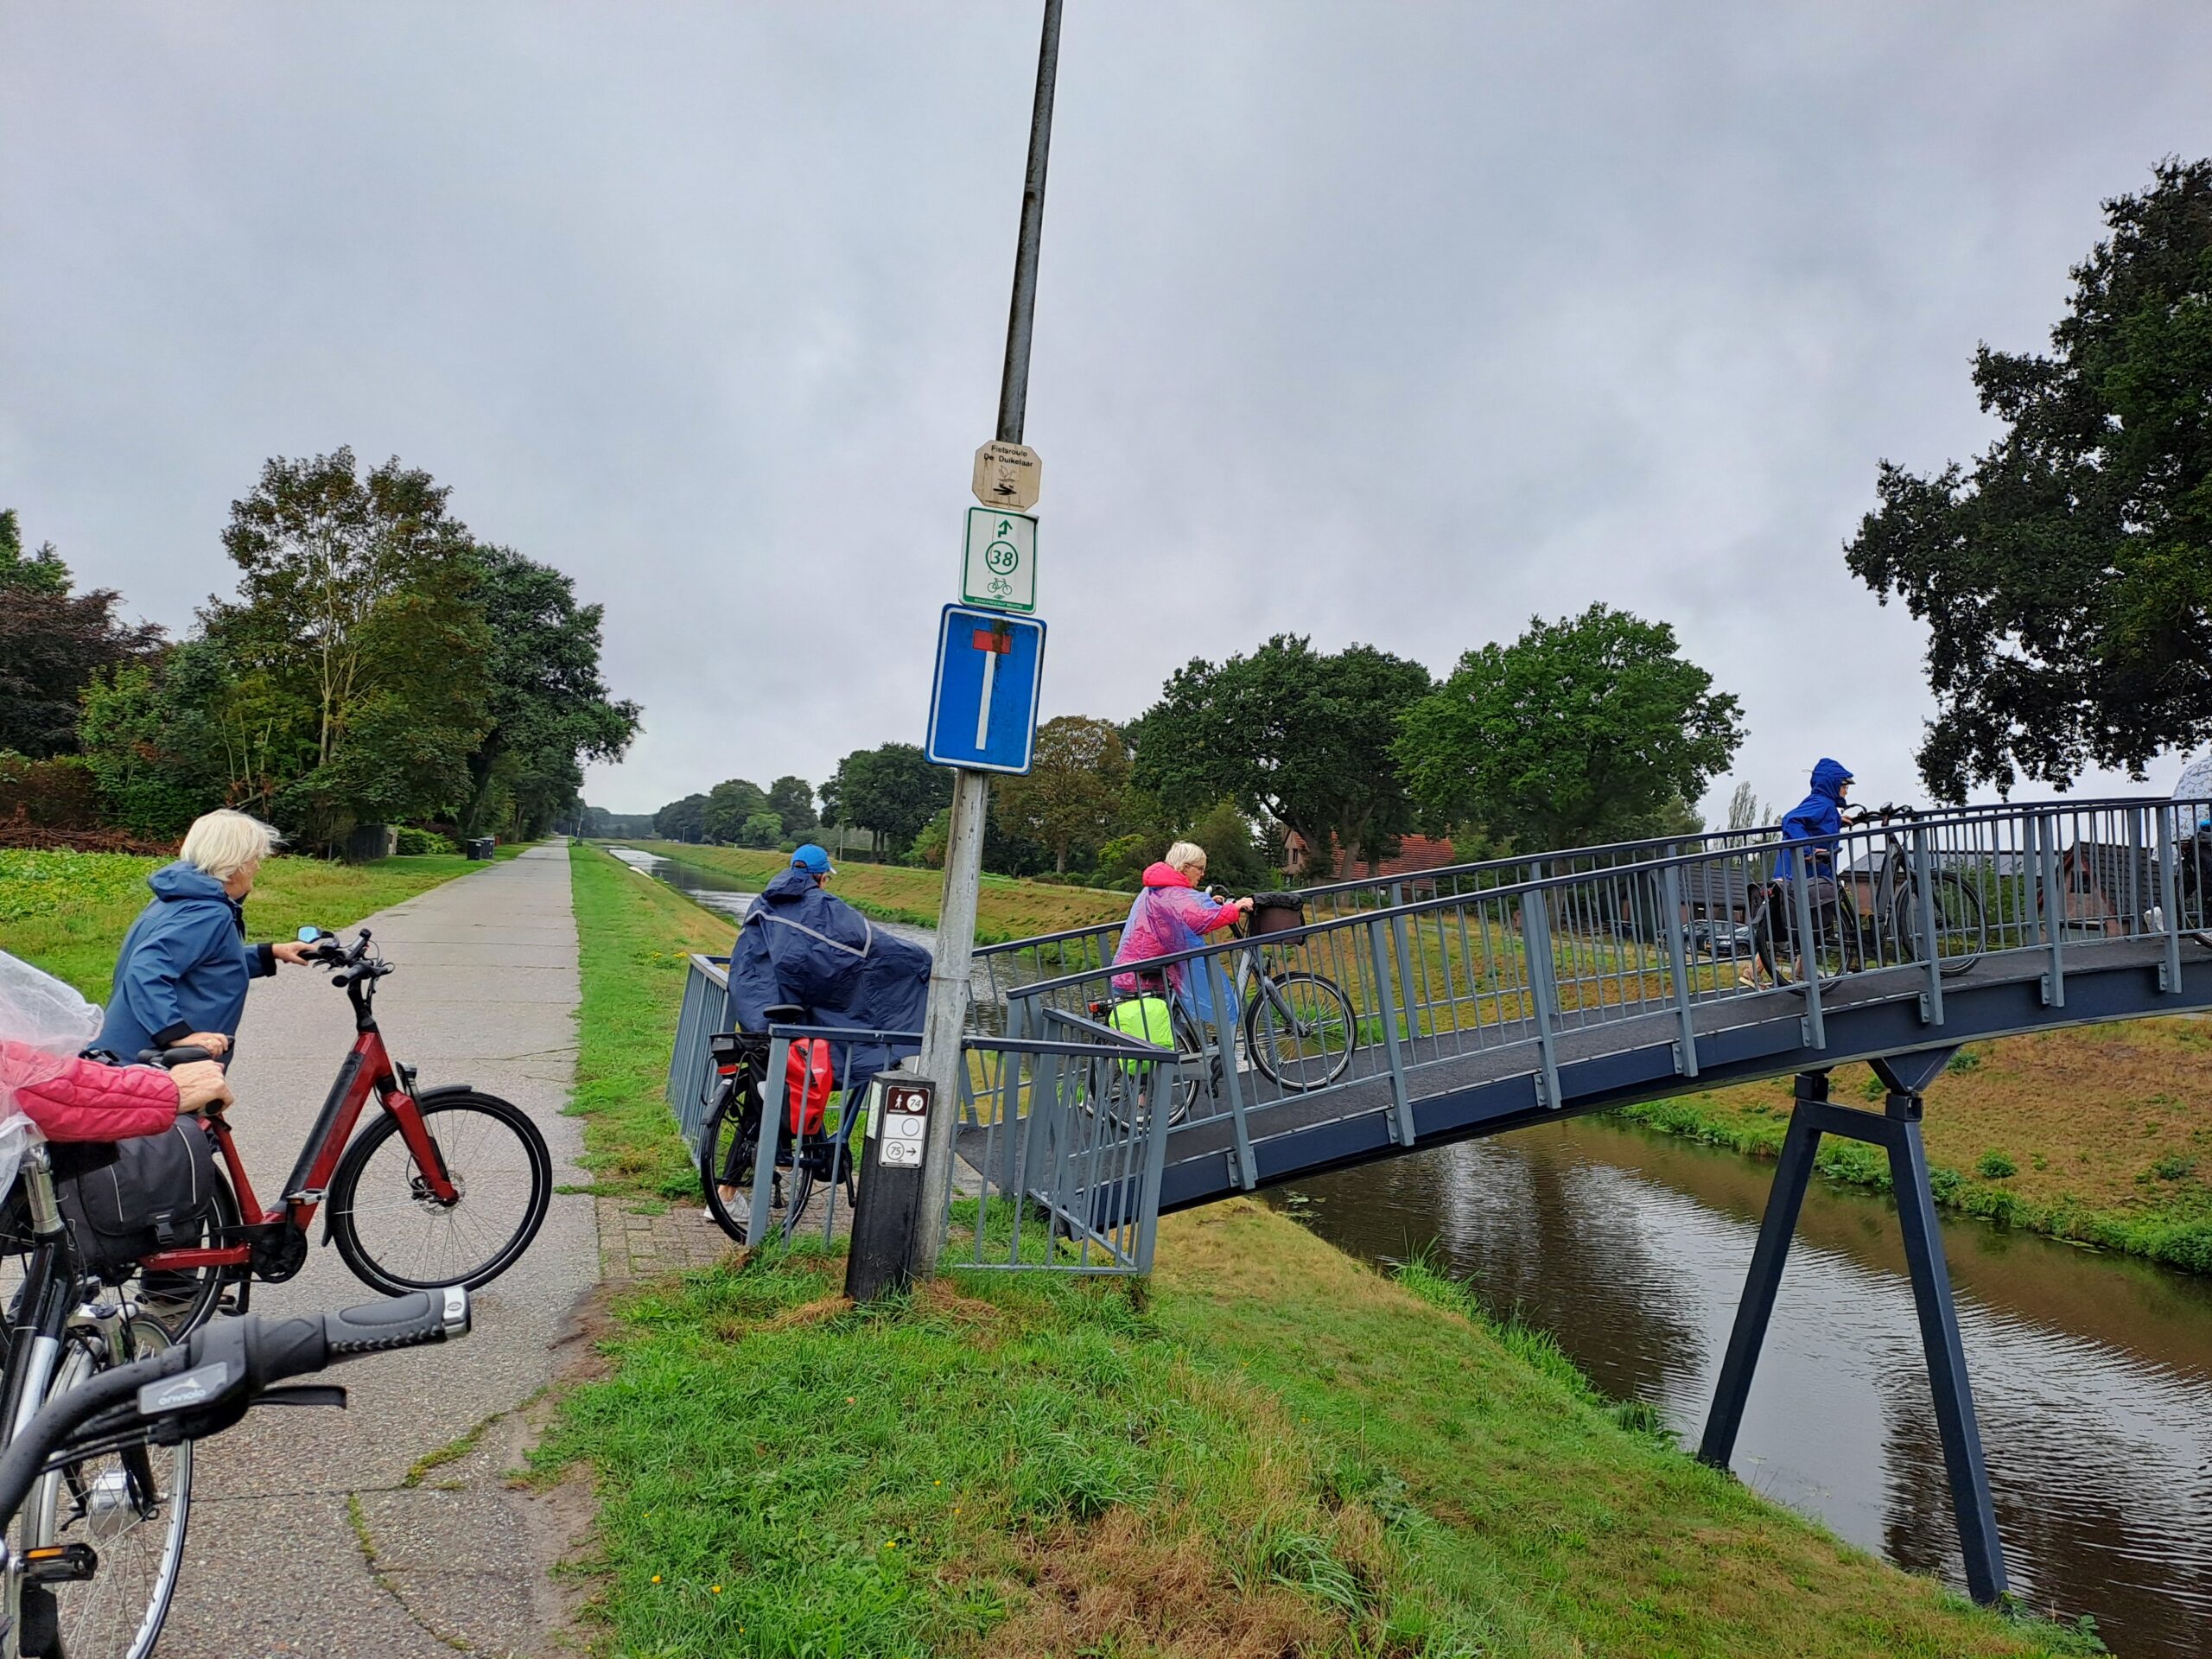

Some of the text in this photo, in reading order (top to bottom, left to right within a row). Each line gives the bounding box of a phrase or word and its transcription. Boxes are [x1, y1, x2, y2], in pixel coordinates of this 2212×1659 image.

[991, 445, 1027, 456] Fietsroute
[999, 455, 1033, 467] Duikelaar
[990, 550, 1014, 567] 38
[910, 1099, 921, 1108] 74
[891, 1147, 901, 1155] 75
